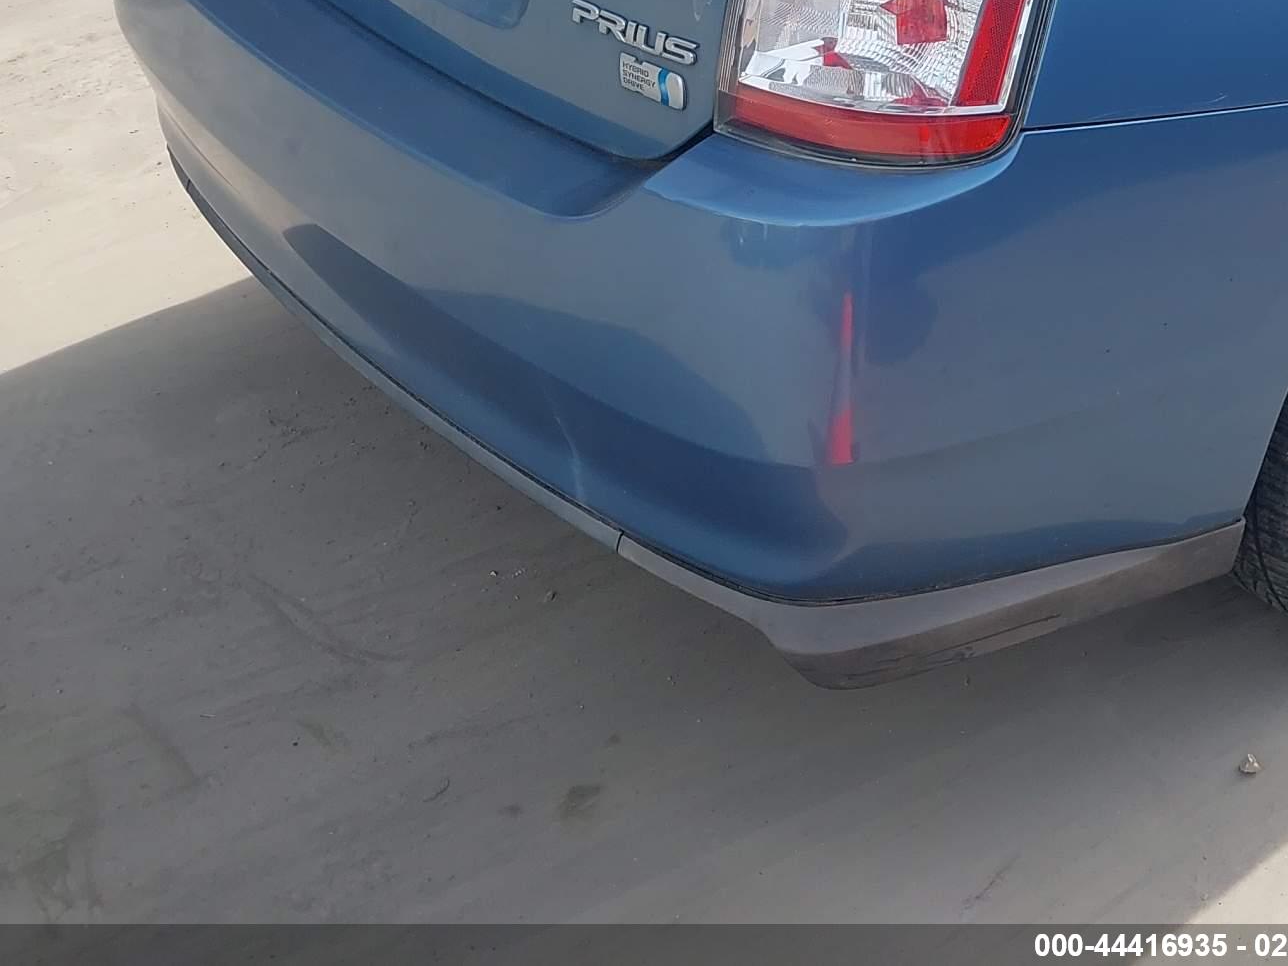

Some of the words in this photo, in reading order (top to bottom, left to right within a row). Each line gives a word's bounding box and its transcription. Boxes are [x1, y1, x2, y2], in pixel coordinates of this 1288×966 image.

[623, 61, 649, 78] HYBRID
[623, 69, 656, 88] SYNERGY
[623, 77, 645, 91] DRIVE
